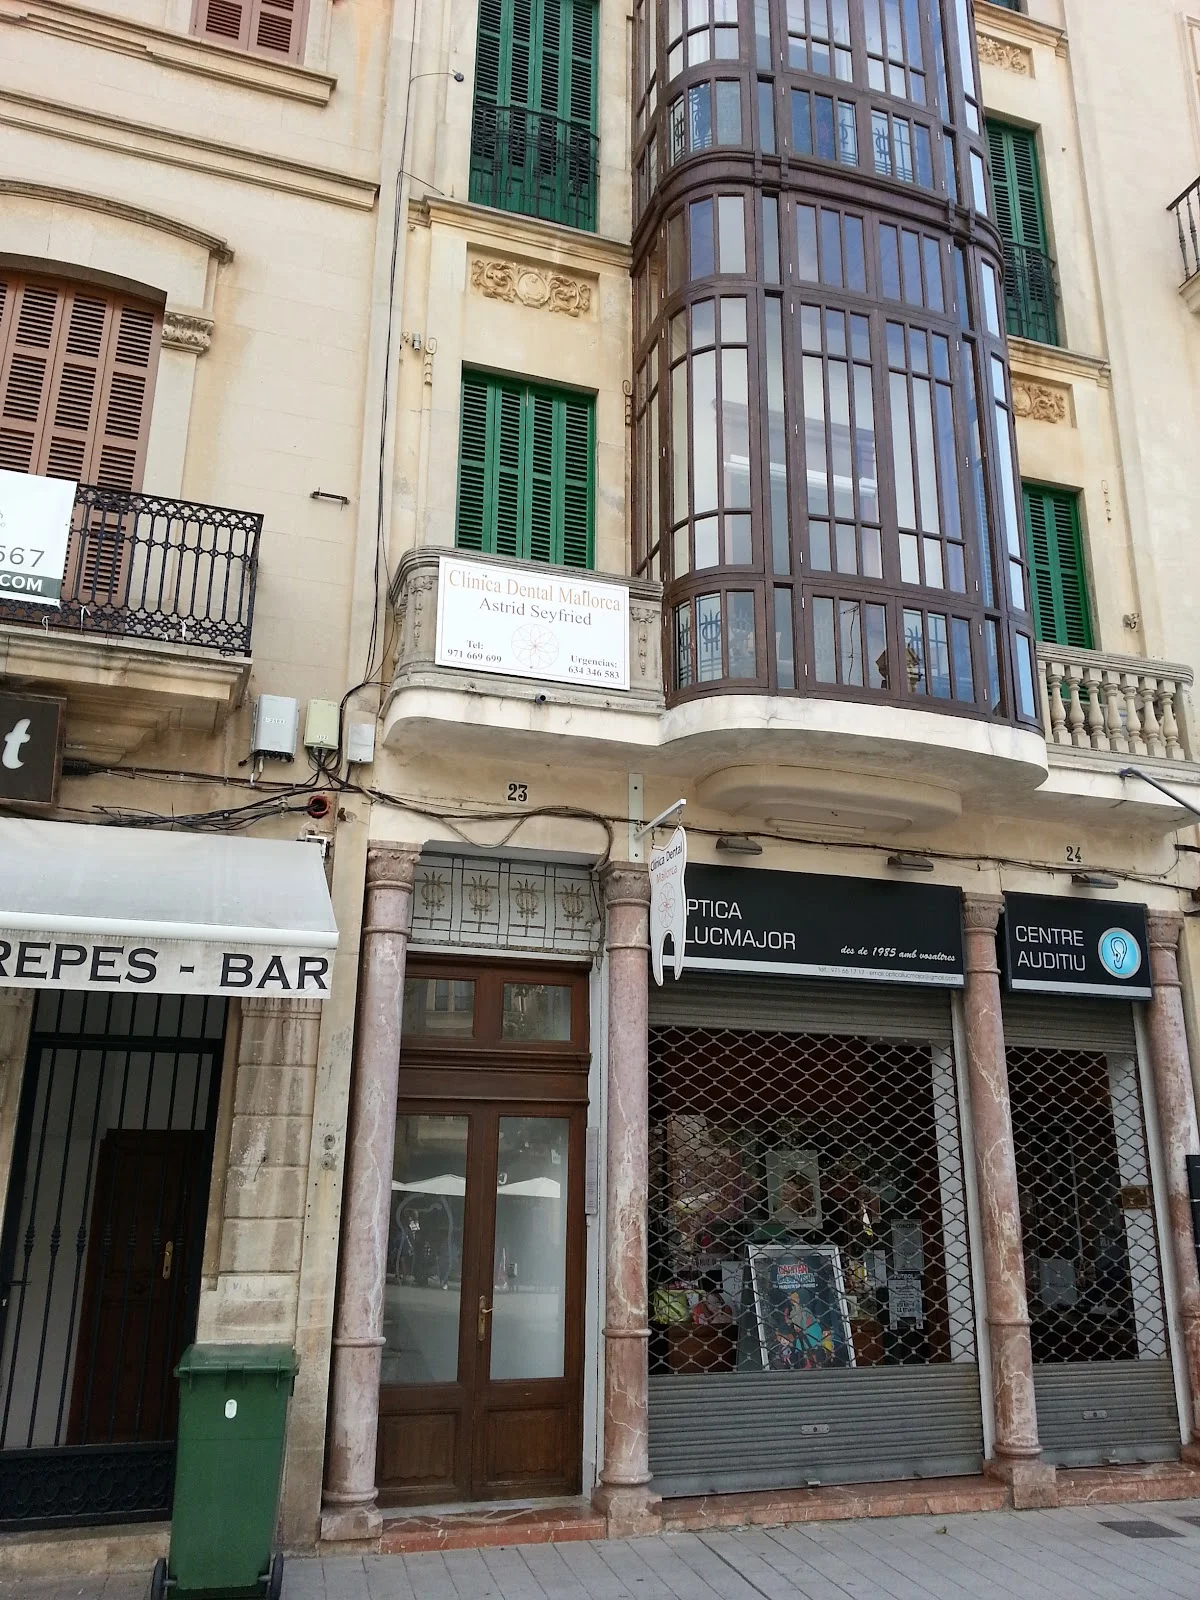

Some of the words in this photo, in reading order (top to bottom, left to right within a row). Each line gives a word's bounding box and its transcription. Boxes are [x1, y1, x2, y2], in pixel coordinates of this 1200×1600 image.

[449, 569, 501, 593] Clínica
[507, 579, 553, 601] Dental
[559, 586, 620, 611] Mallorca
[480, 597, 525, 616] Astrid
[531, 604, 592, 625] Seyfried
[467, 640, 484, 650] Tel:
[447, 649, 463, 658] 971
[467, 652, 483, 660] 669
[486, 654, 502, 662] 699
[571, 655, 617, 668] Urgencias:
[568, 665, 584, 674] 634
[586, 667, 602, 677] 346
[604, 670, 620, 679] 583
[507, 783, 528, 802] 23
[1066, 845, 1082, 862] 24
[686, 898, 742, 919] PTICA
[1015, 925, 1085, 947] CENTRE
[840, 945, 855, 954] des
[858, 947, 868, 955] de
[872, 946, 896, 957] 1985
[899, 949, 917, 958] amb
[919, 952, 955, 961] vosaltres
[1017, 950, 1086, 971] AUDITIU
[219, 952, 328, 990] BAR
